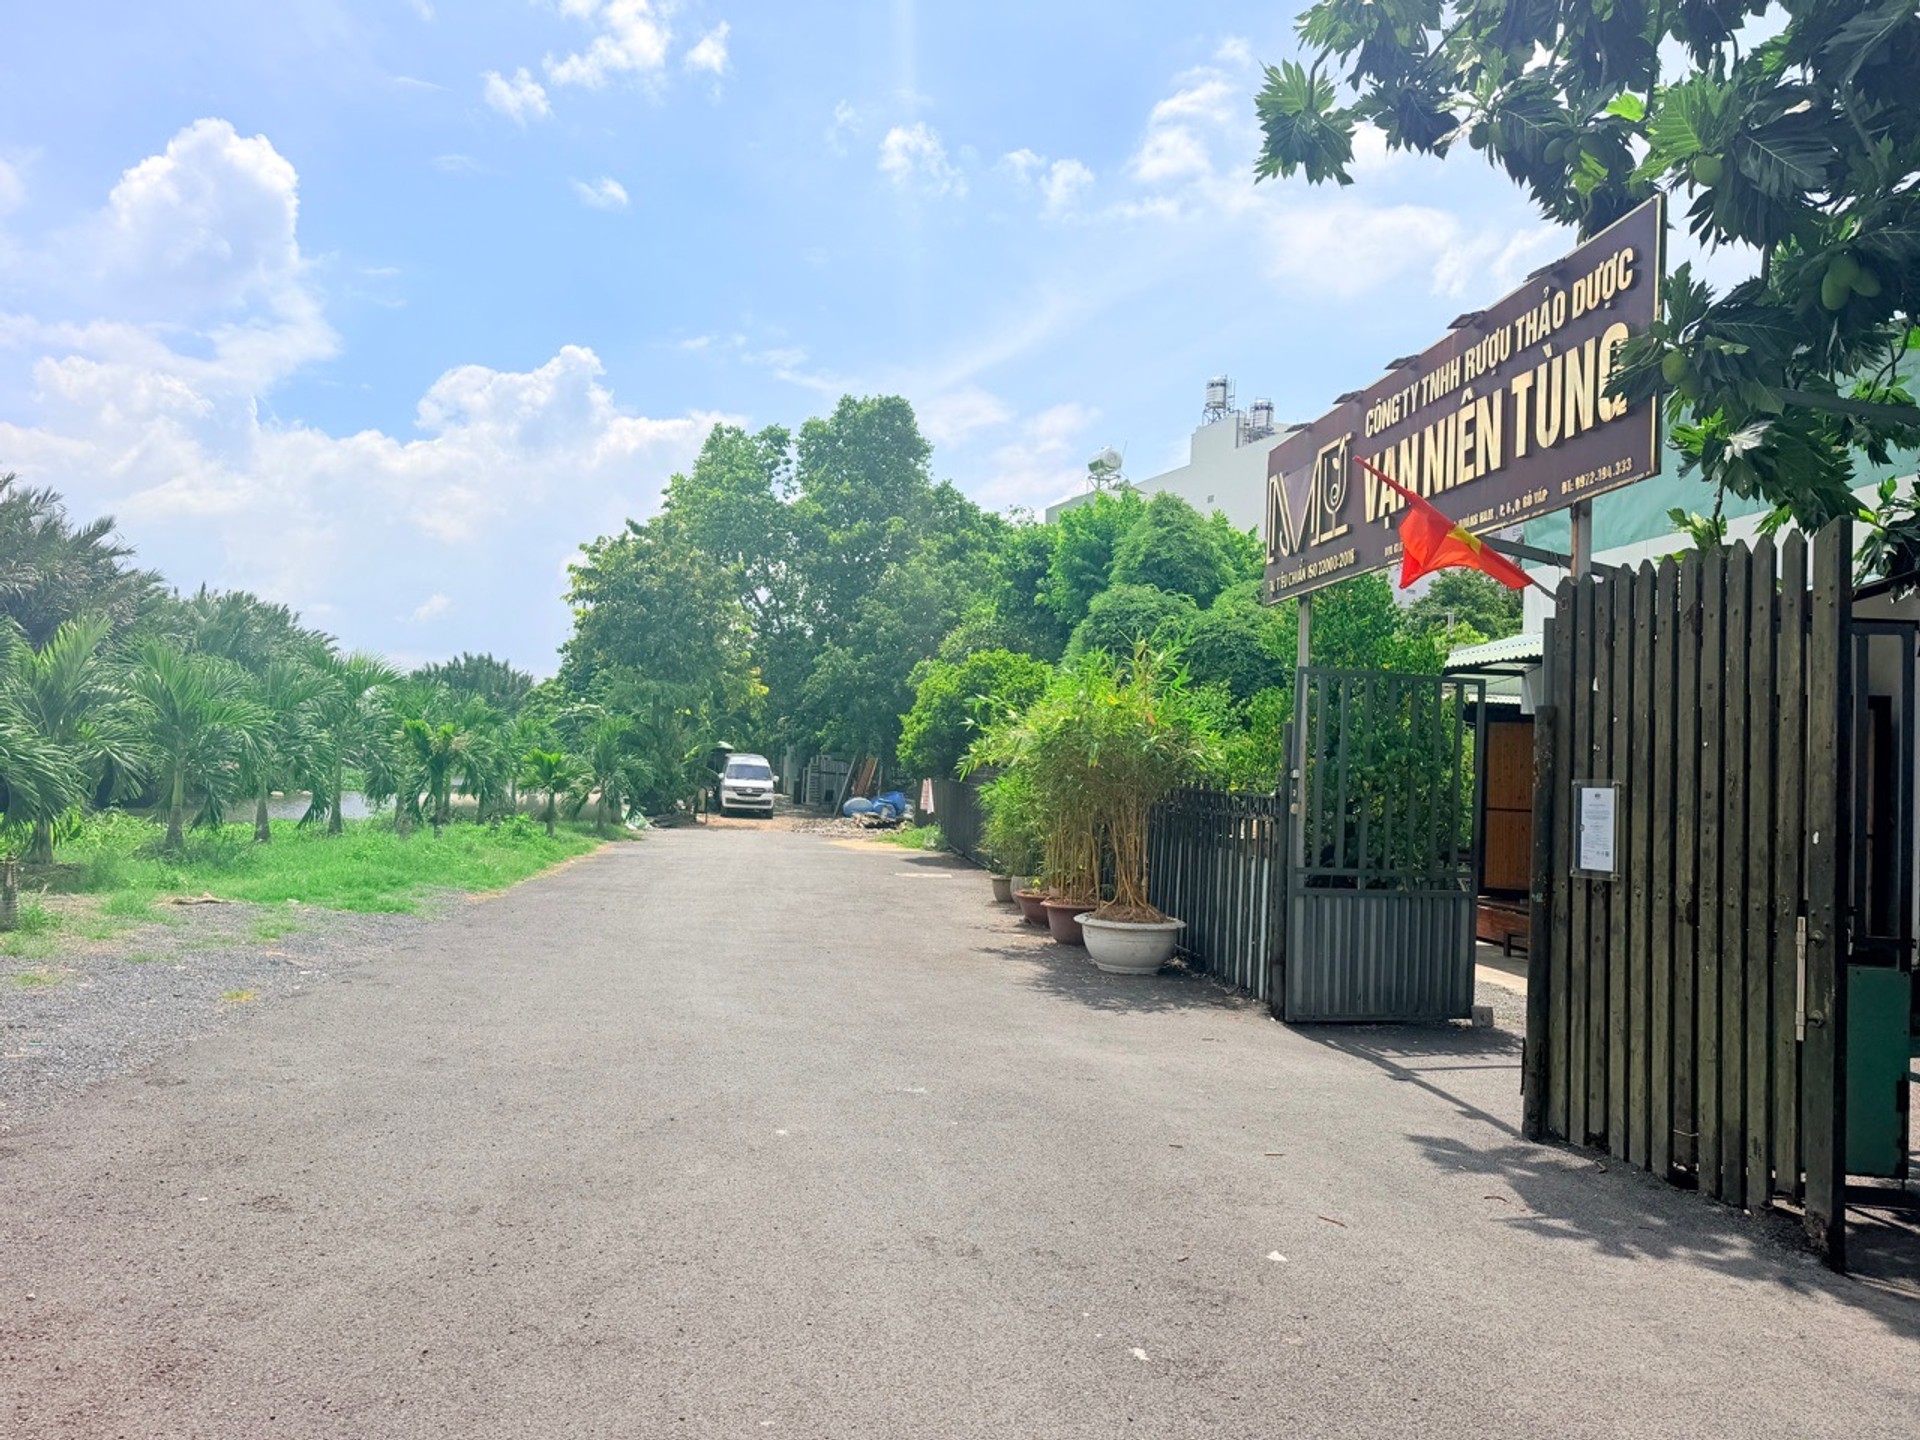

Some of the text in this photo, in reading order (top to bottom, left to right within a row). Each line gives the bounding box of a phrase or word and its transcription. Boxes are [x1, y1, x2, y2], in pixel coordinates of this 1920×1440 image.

[1363, 322, 1629, 530] VẠN NIÊN TÙNG
[1365, 248, 1634, 438] CÔNG TY TNHH RƯỢU THẢO DƯỢC
